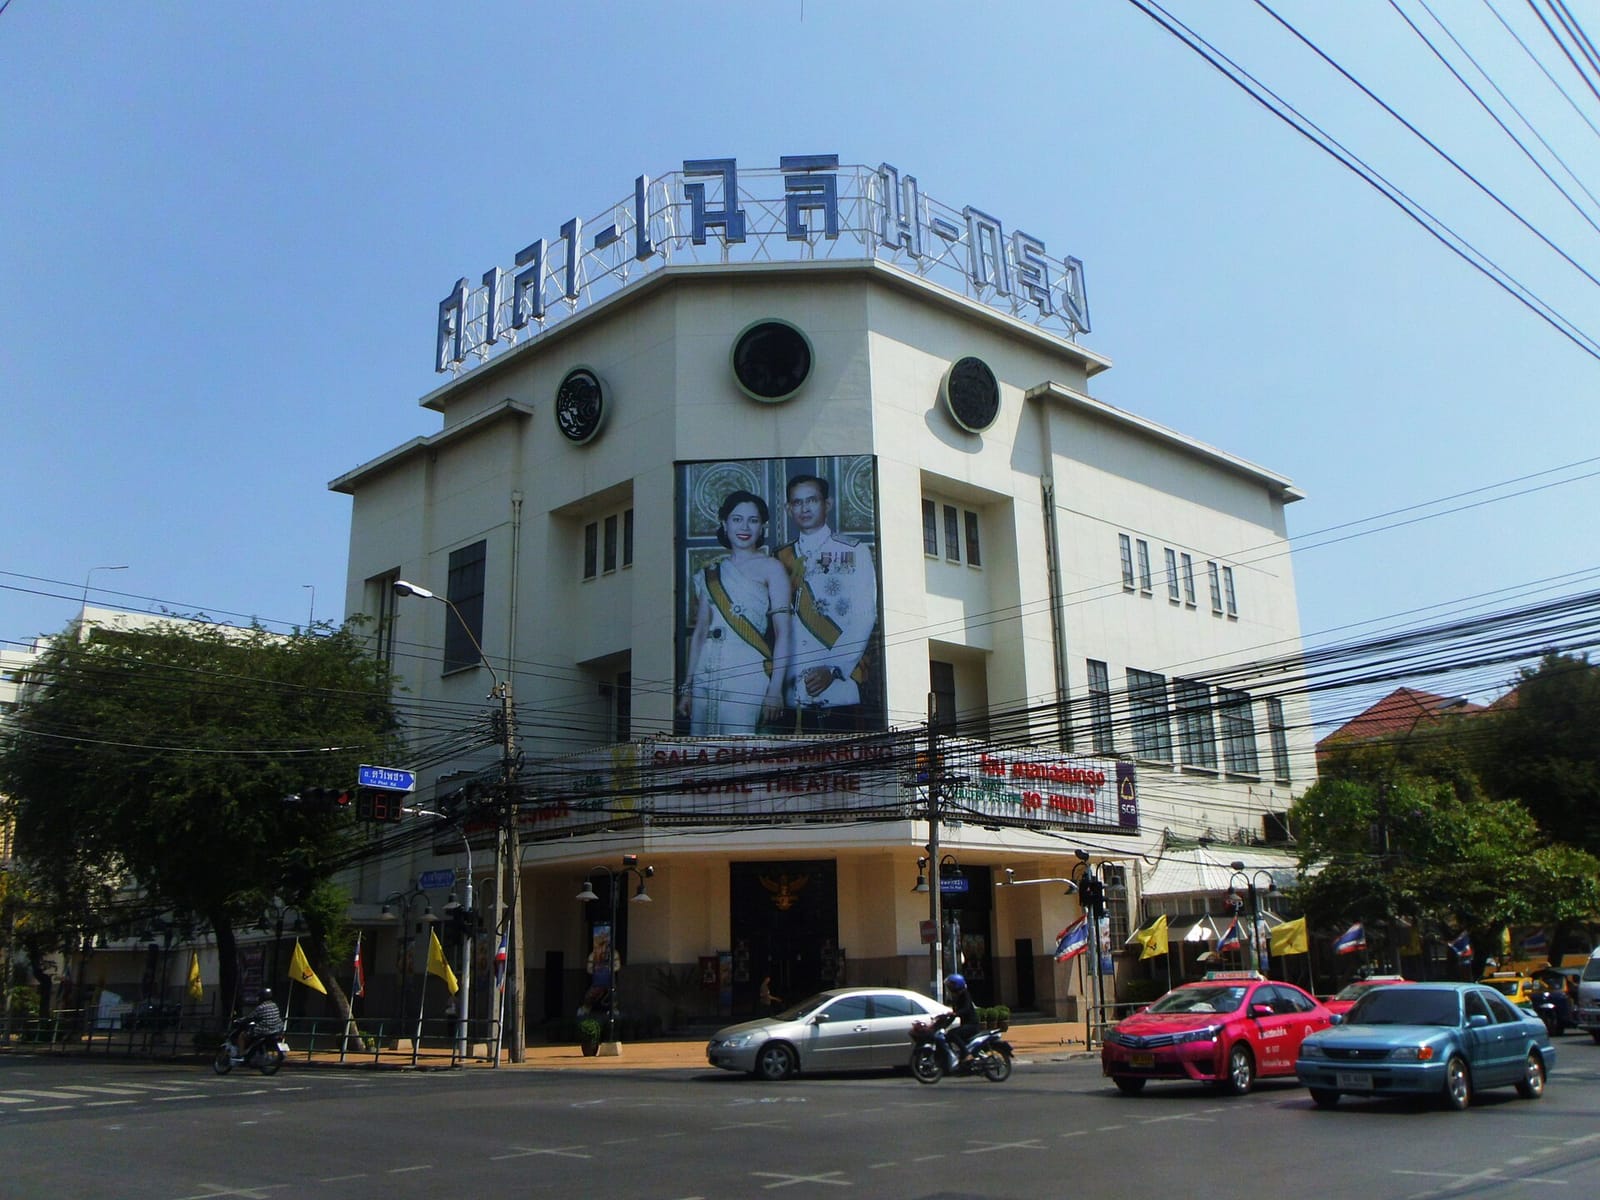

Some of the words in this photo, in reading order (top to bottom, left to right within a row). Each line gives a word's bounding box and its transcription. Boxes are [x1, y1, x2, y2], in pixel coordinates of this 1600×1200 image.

[654, 748, 709, 765] SALA
[716, 746, 893, 764] CHAMKRUNG
[682, 778, 752, 794] ROYAL
[767, 775, 861, 793] THEATRE
[1121, 803, 1136, 815] SCB
